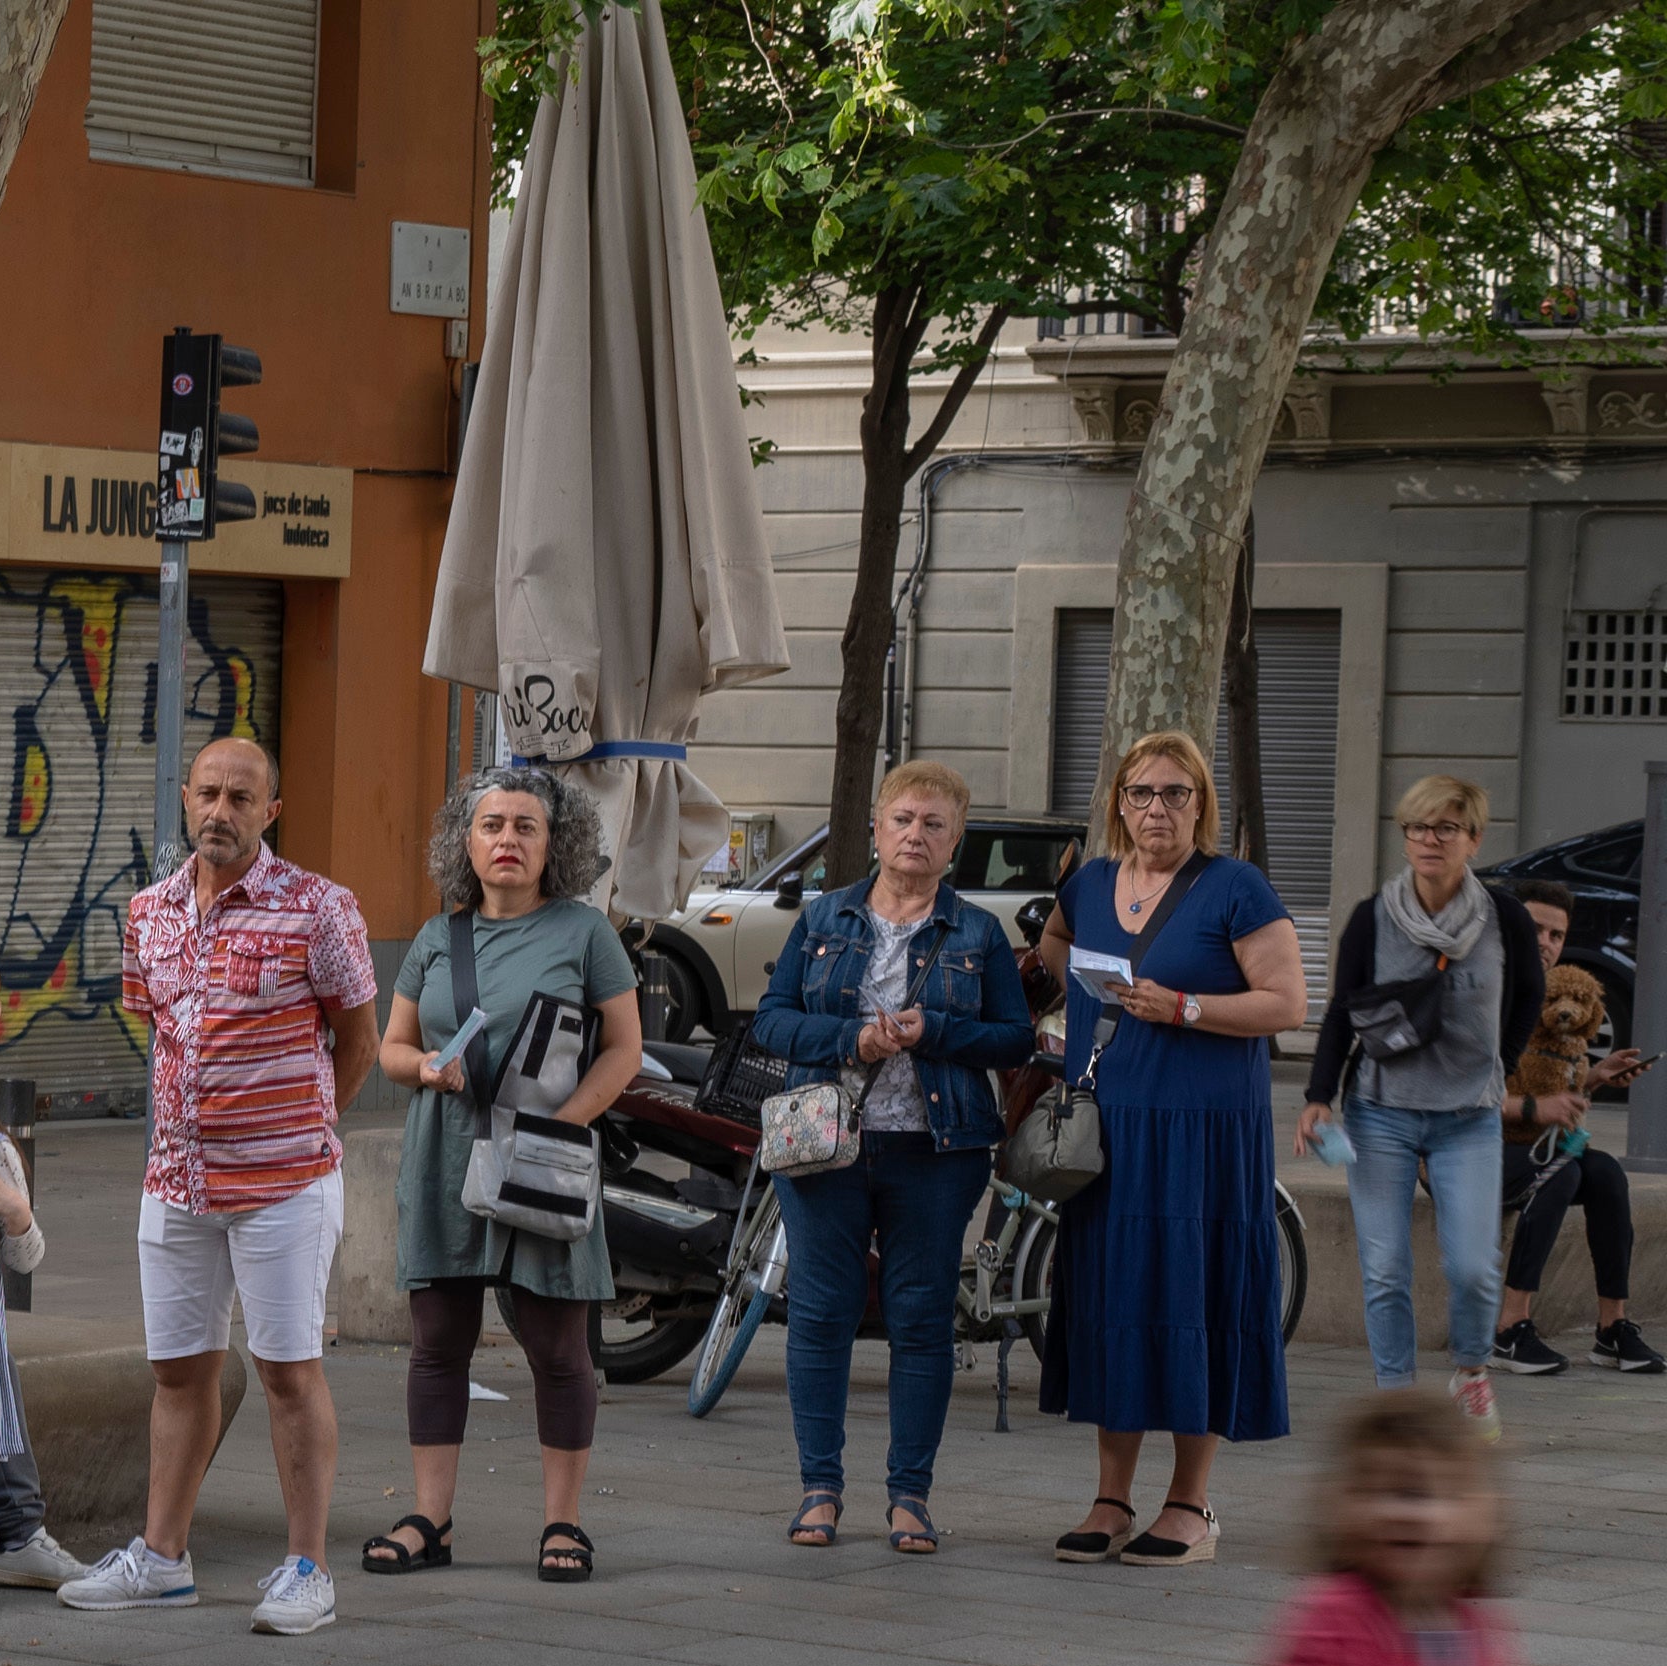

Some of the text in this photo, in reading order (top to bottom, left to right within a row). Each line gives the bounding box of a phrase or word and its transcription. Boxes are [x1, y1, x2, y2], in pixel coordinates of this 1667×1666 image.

[43, 475, 78, 534] LA
[85, 477, 157, 538] JUNG
[288, 491, 301, 516] de
[303, 494, 330, 518] taula
[283, 522, 329, 548] ludoteca
